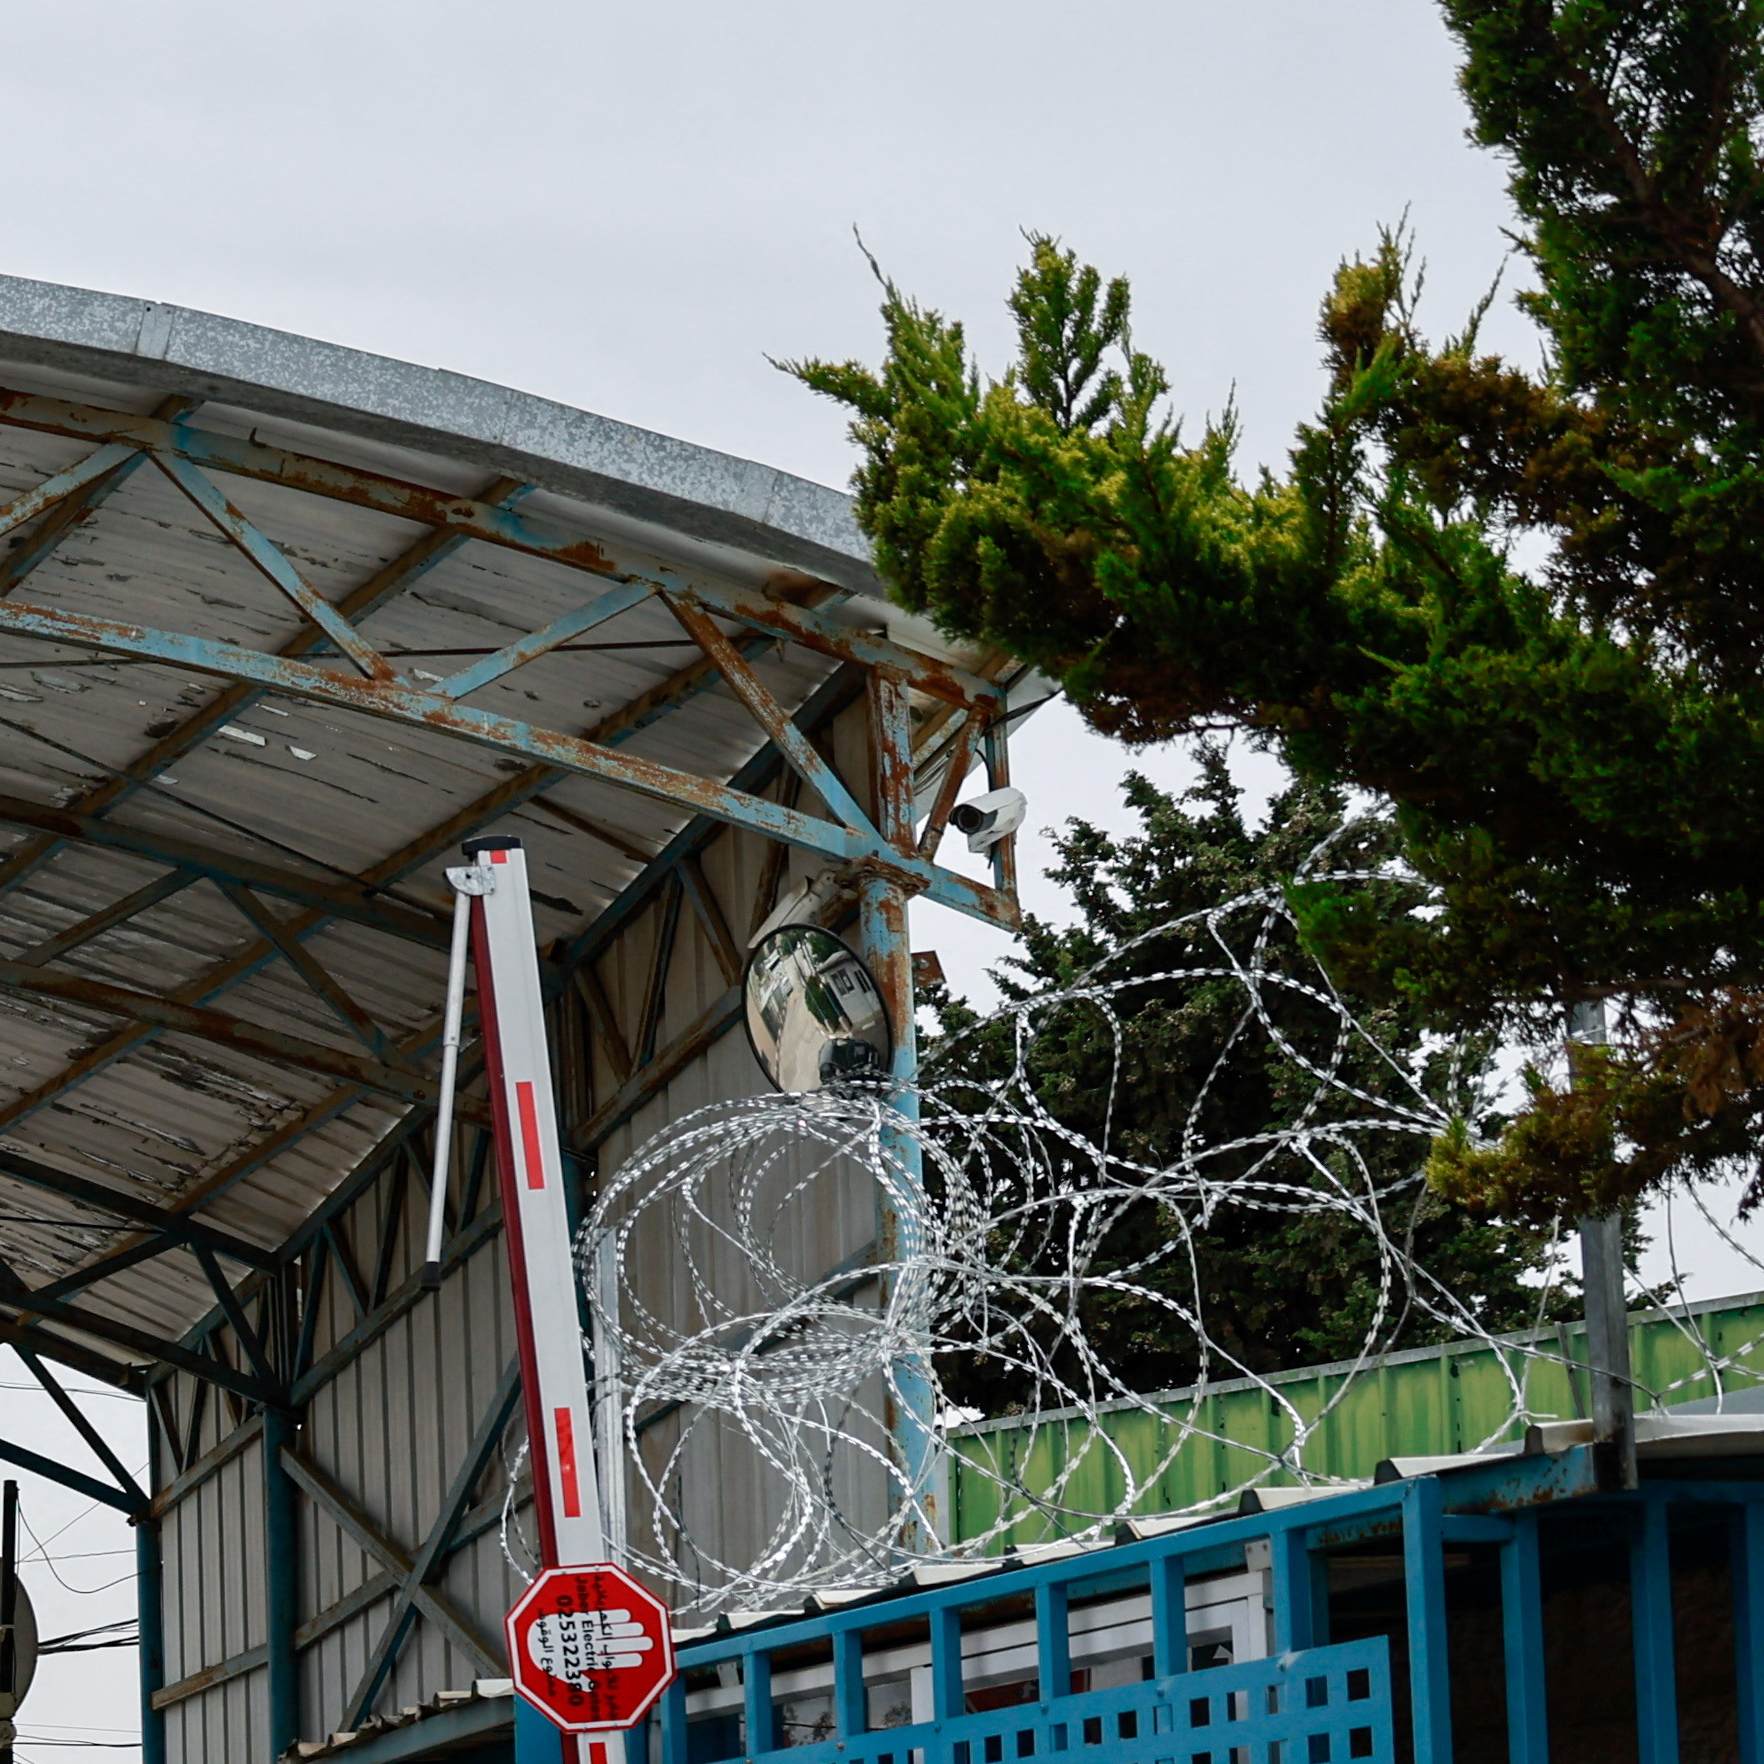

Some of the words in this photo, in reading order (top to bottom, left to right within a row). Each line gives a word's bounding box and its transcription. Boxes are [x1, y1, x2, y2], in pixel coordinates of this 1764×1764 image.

[576, 1575, 592, 1615] Jaber
[556, 1594, 584, 1707] 025322380
[581, 1619, 598, 1673] Electric
